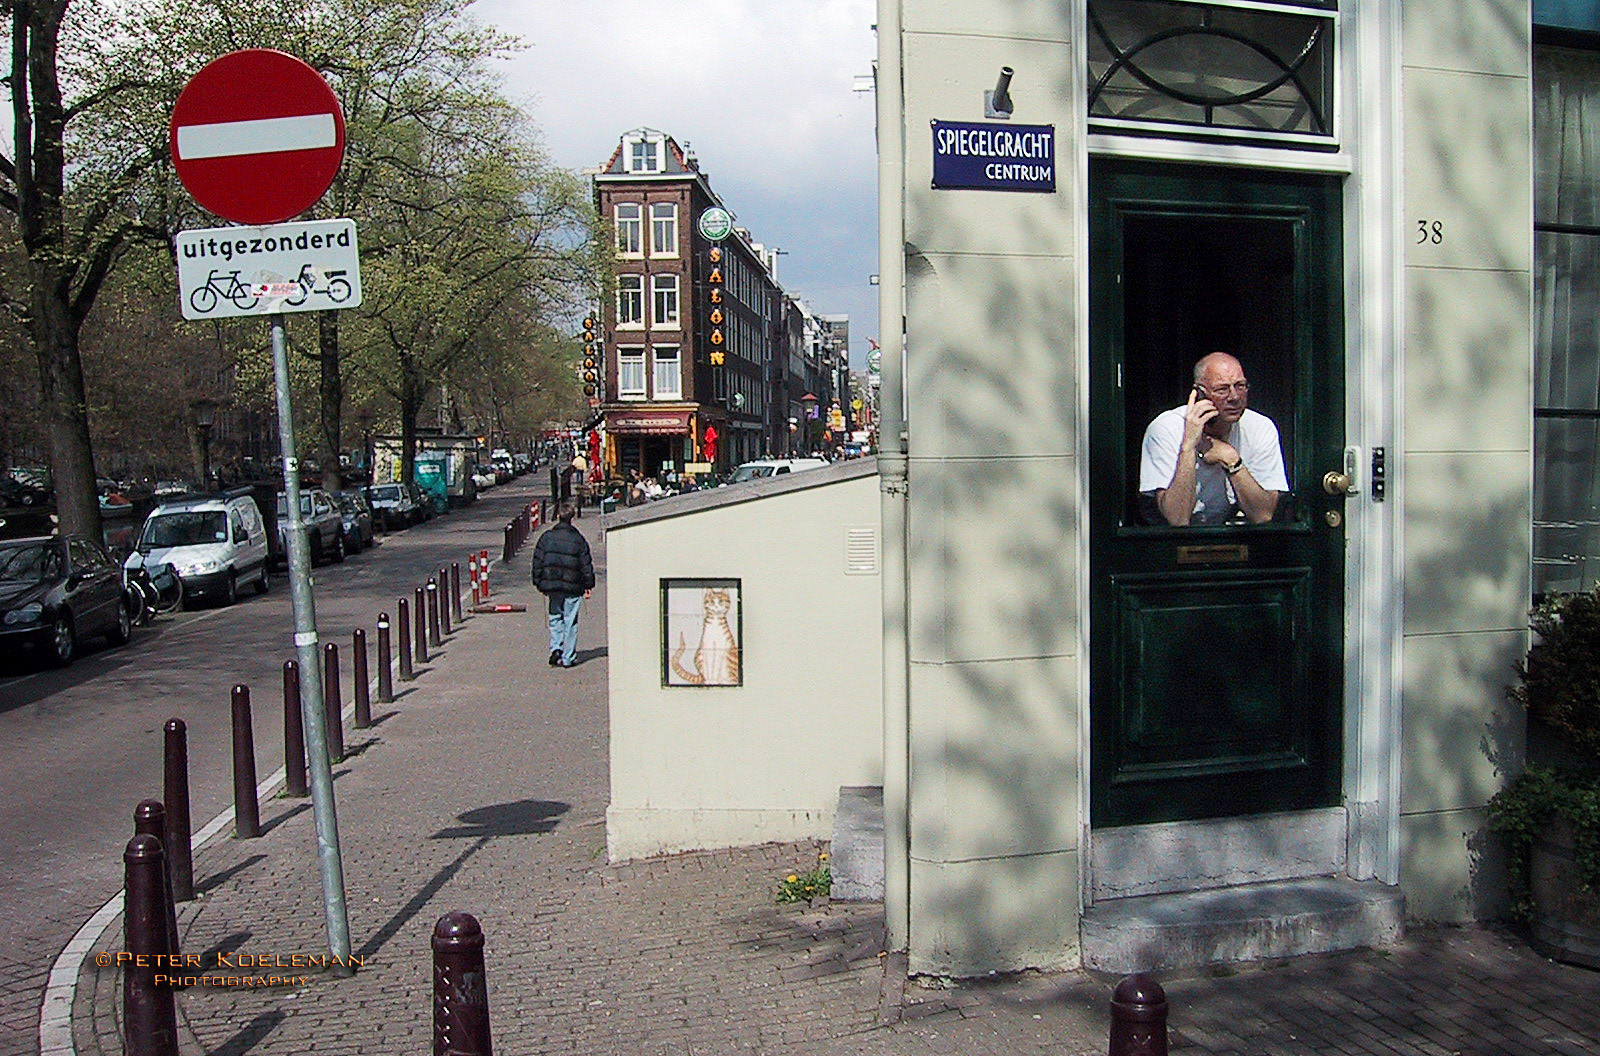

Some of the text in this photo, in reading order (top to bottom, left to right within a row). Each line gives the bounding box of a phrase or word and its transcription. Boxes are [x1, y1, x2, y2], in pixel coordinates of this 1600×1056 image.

[937, 129, 1051, 159] SPIEGELGRACHT
[985, 163, 1051, 181] CENTRUM
[183, 228, 351, 262] uitgezonderd
[1417, 220, 1443, 245] 38
[708, 247, 725, 366] SALOON
